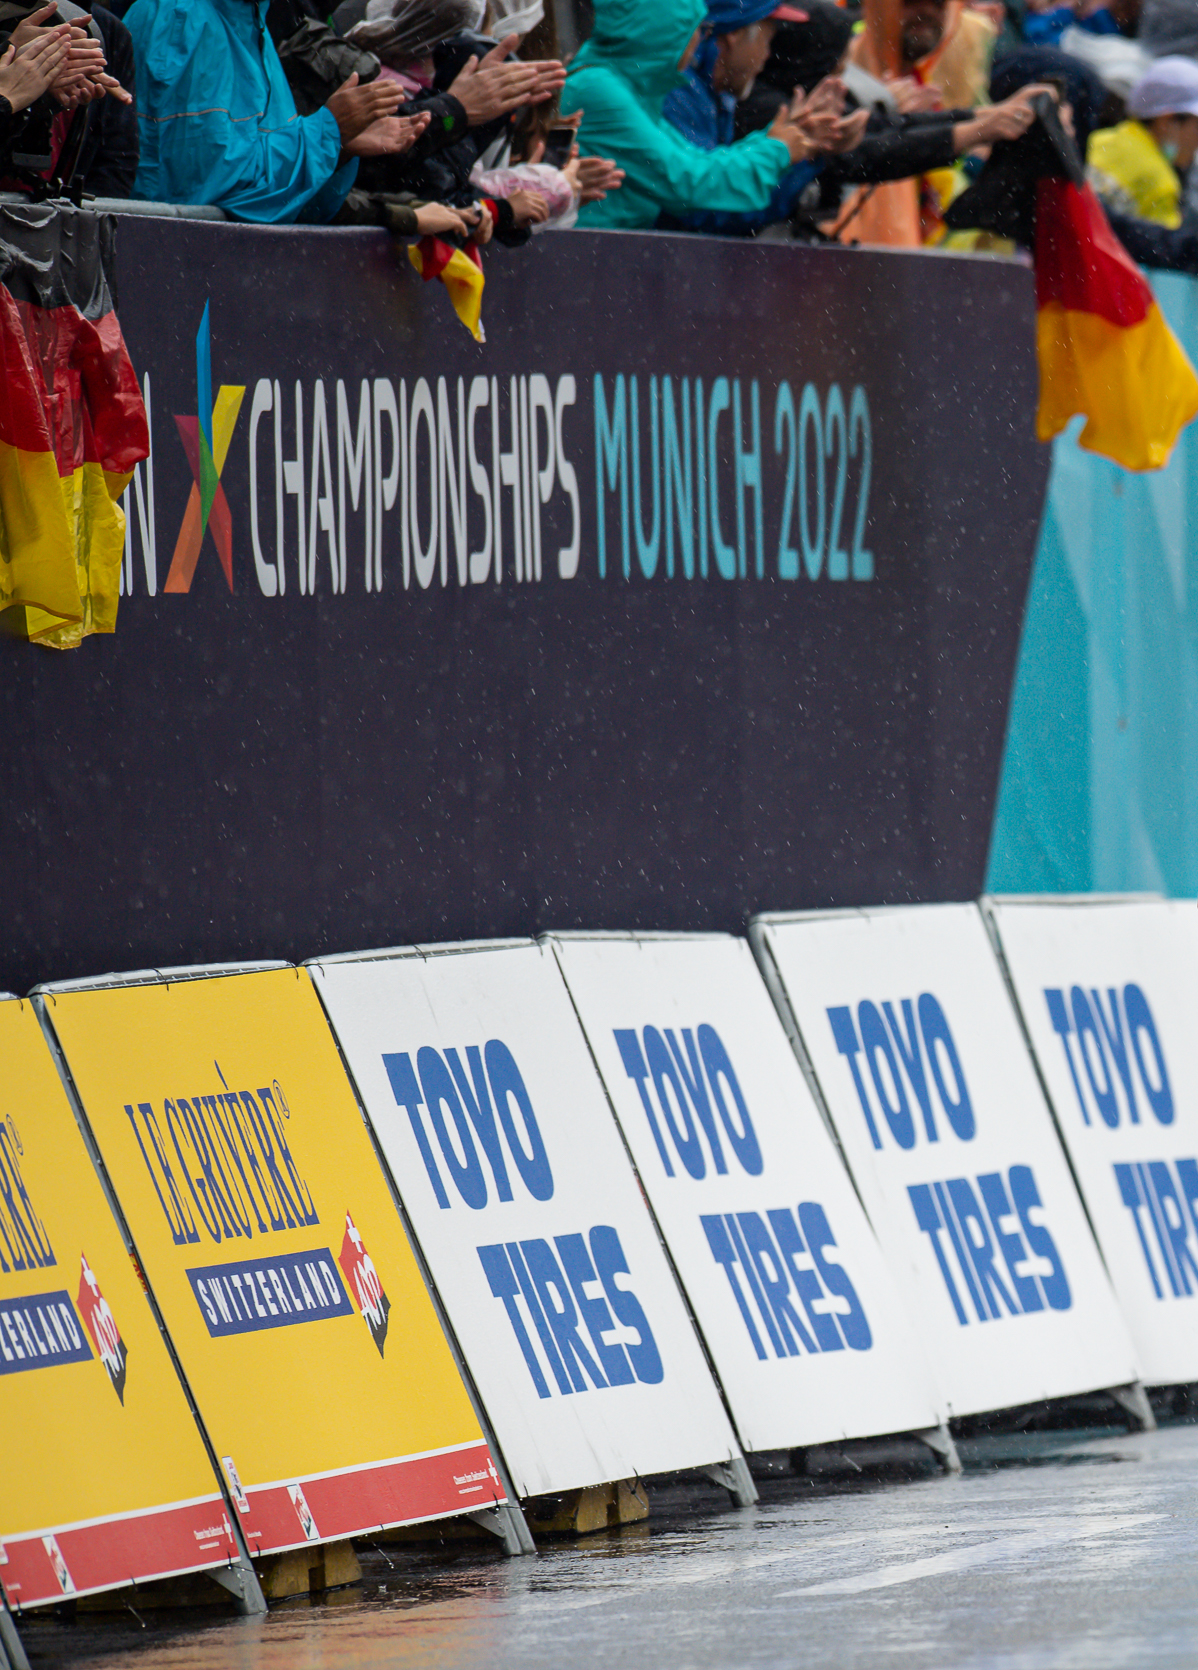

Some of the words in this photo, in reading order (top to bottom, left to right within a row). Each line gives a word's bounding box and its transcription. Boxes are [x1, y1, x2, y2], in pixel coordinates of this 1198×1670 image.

[249, 374, 582, 597] CHAMPIONSHIPS
[593, 373, 765, 580] MUNICH
[774, 380, 875, 581] 2022
[381, 1039, 555, 1211] TOYO
[611, 1023, 765, 1181] TOYO
[825, 992, 977, 1151] TOYO
[1042, 982, 1176, 1130] TOYO
[123, 1102, 202, 1246] LE
[906, 1164, 1074, 1327] TIRES
[196, 1260, 342, 1326] SWITZERLAND
[476, 1225, 665, 1400] TIRES
[698, 1201, 874, 1362] TIRES
